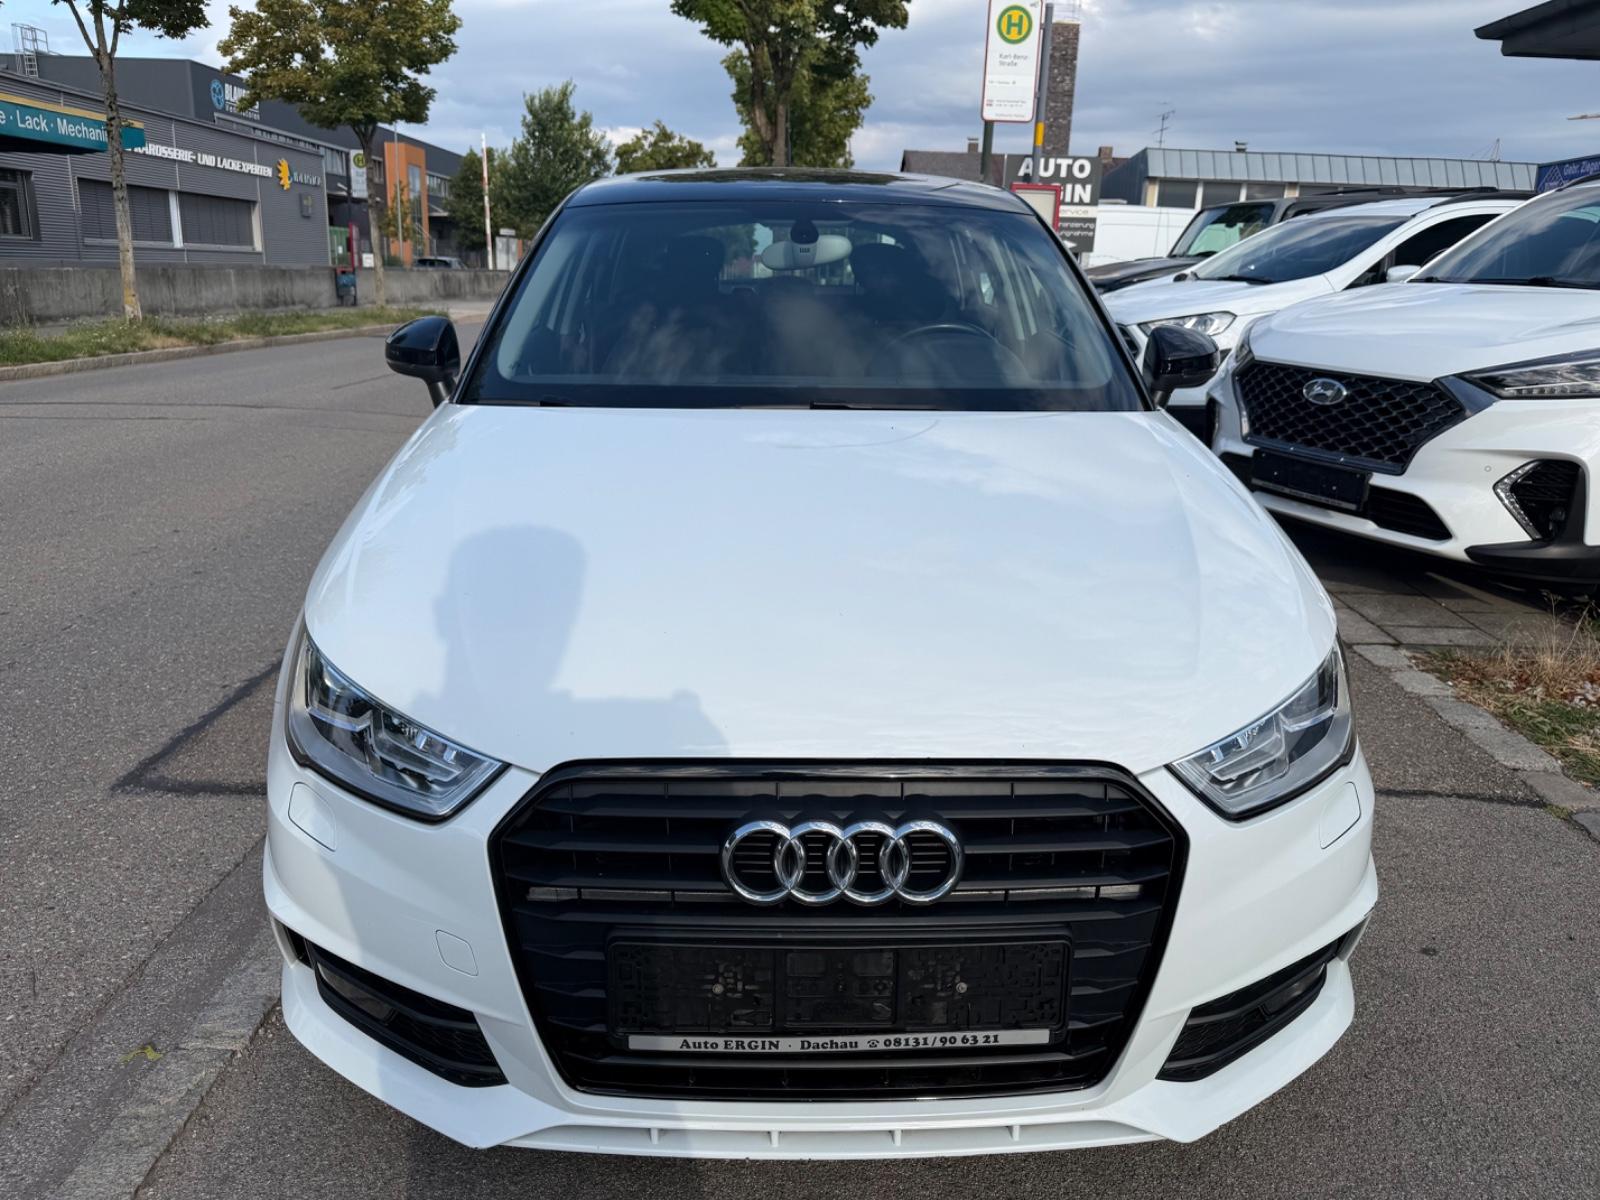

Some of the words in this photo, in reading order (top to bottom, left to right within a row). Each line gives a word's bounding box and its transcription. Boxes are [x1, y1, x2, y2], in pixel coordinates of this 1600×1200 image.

[16, 110, 48, 132] Lack
[197, 153, 215, 167] UND
[217, 157, 272, 177] LACKEXPERTEN
[1018, 157, 1091, 179] AUTO
[679, 1039, 719, 1050] Auto
[723, 1039, 781, 1051] ERGIN
[799, 1039, 858, 1050] Dachau
[961, 1034, 978, 1045] 63
[982, 1033, 1000, 1044] 21
